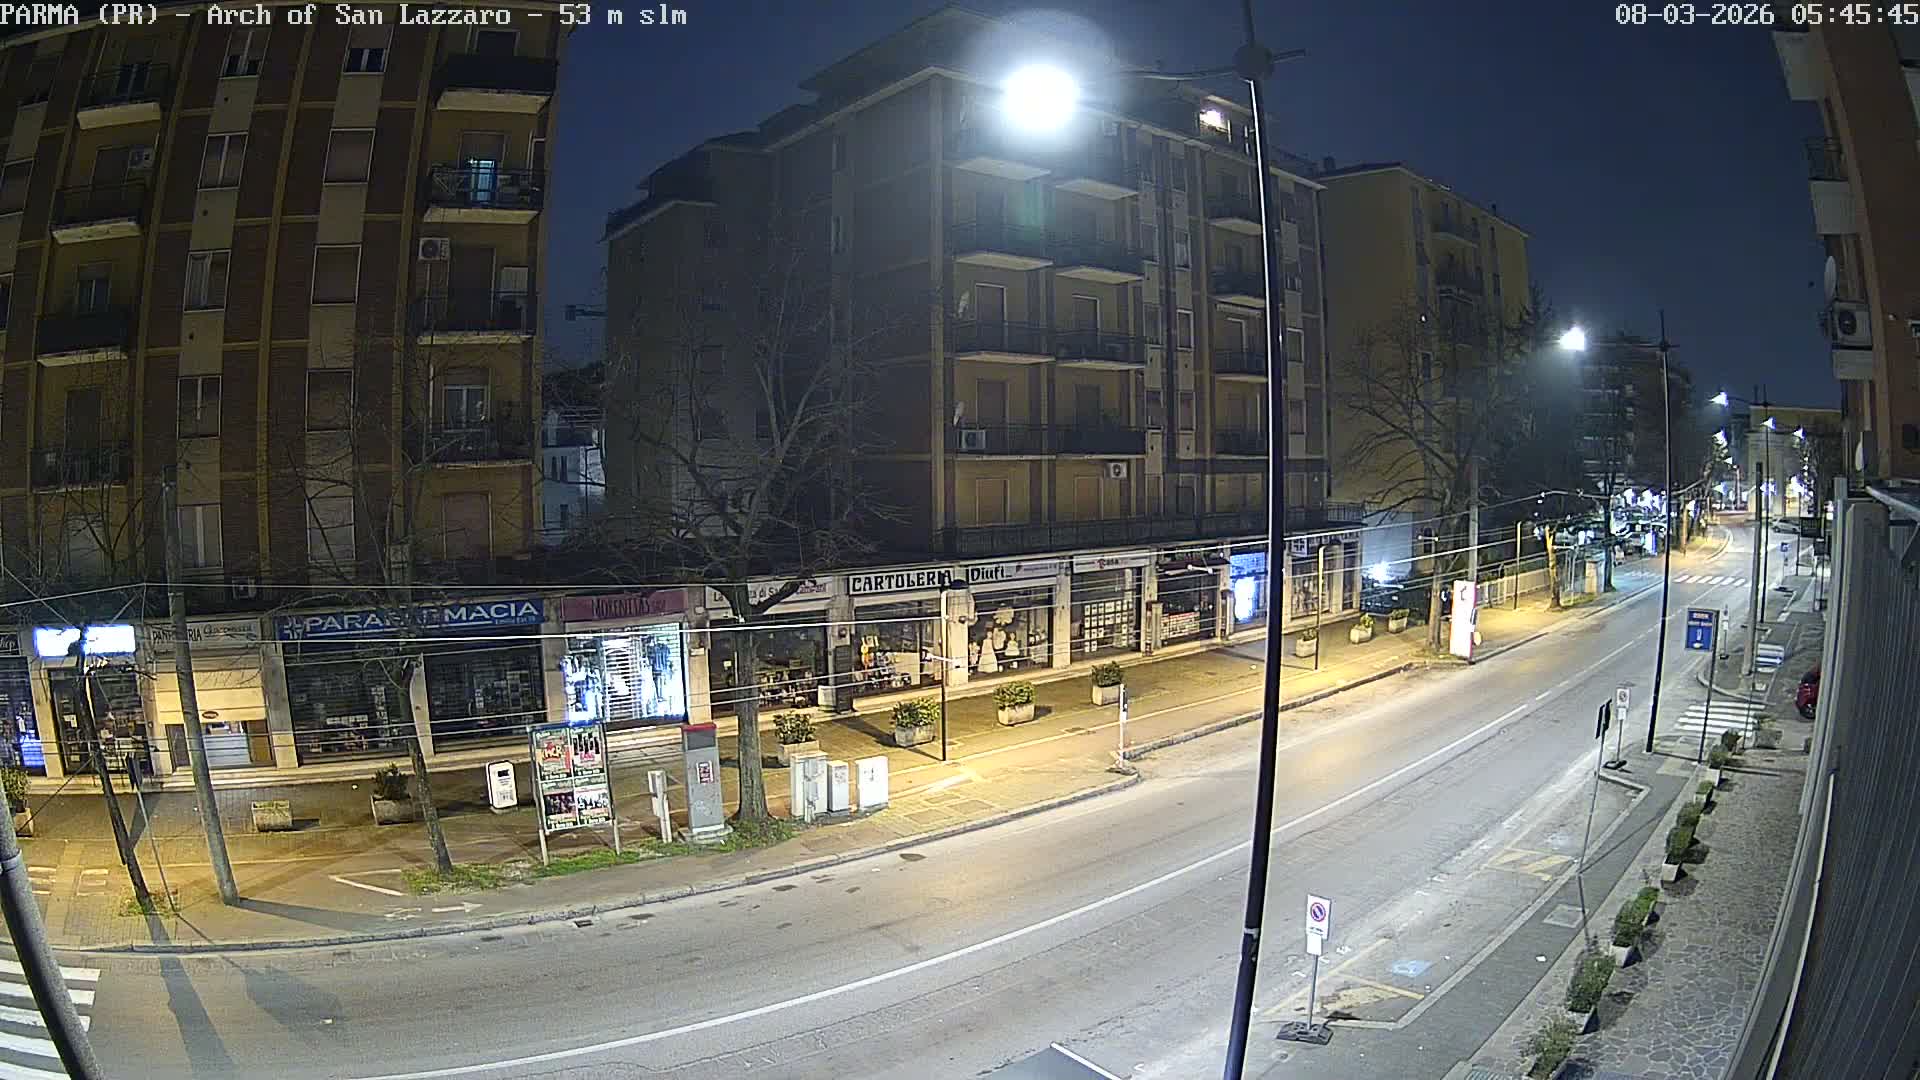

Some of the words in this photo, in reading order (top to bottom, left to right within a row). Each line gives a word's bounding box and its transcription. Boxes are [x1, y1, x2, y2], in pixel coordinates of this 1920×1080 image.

[851, 570, 951, 592] CARTOLERIA
[305, 602, 539, 632] PARAFMACIA
[152, 628, 203, 645] PANRIA
